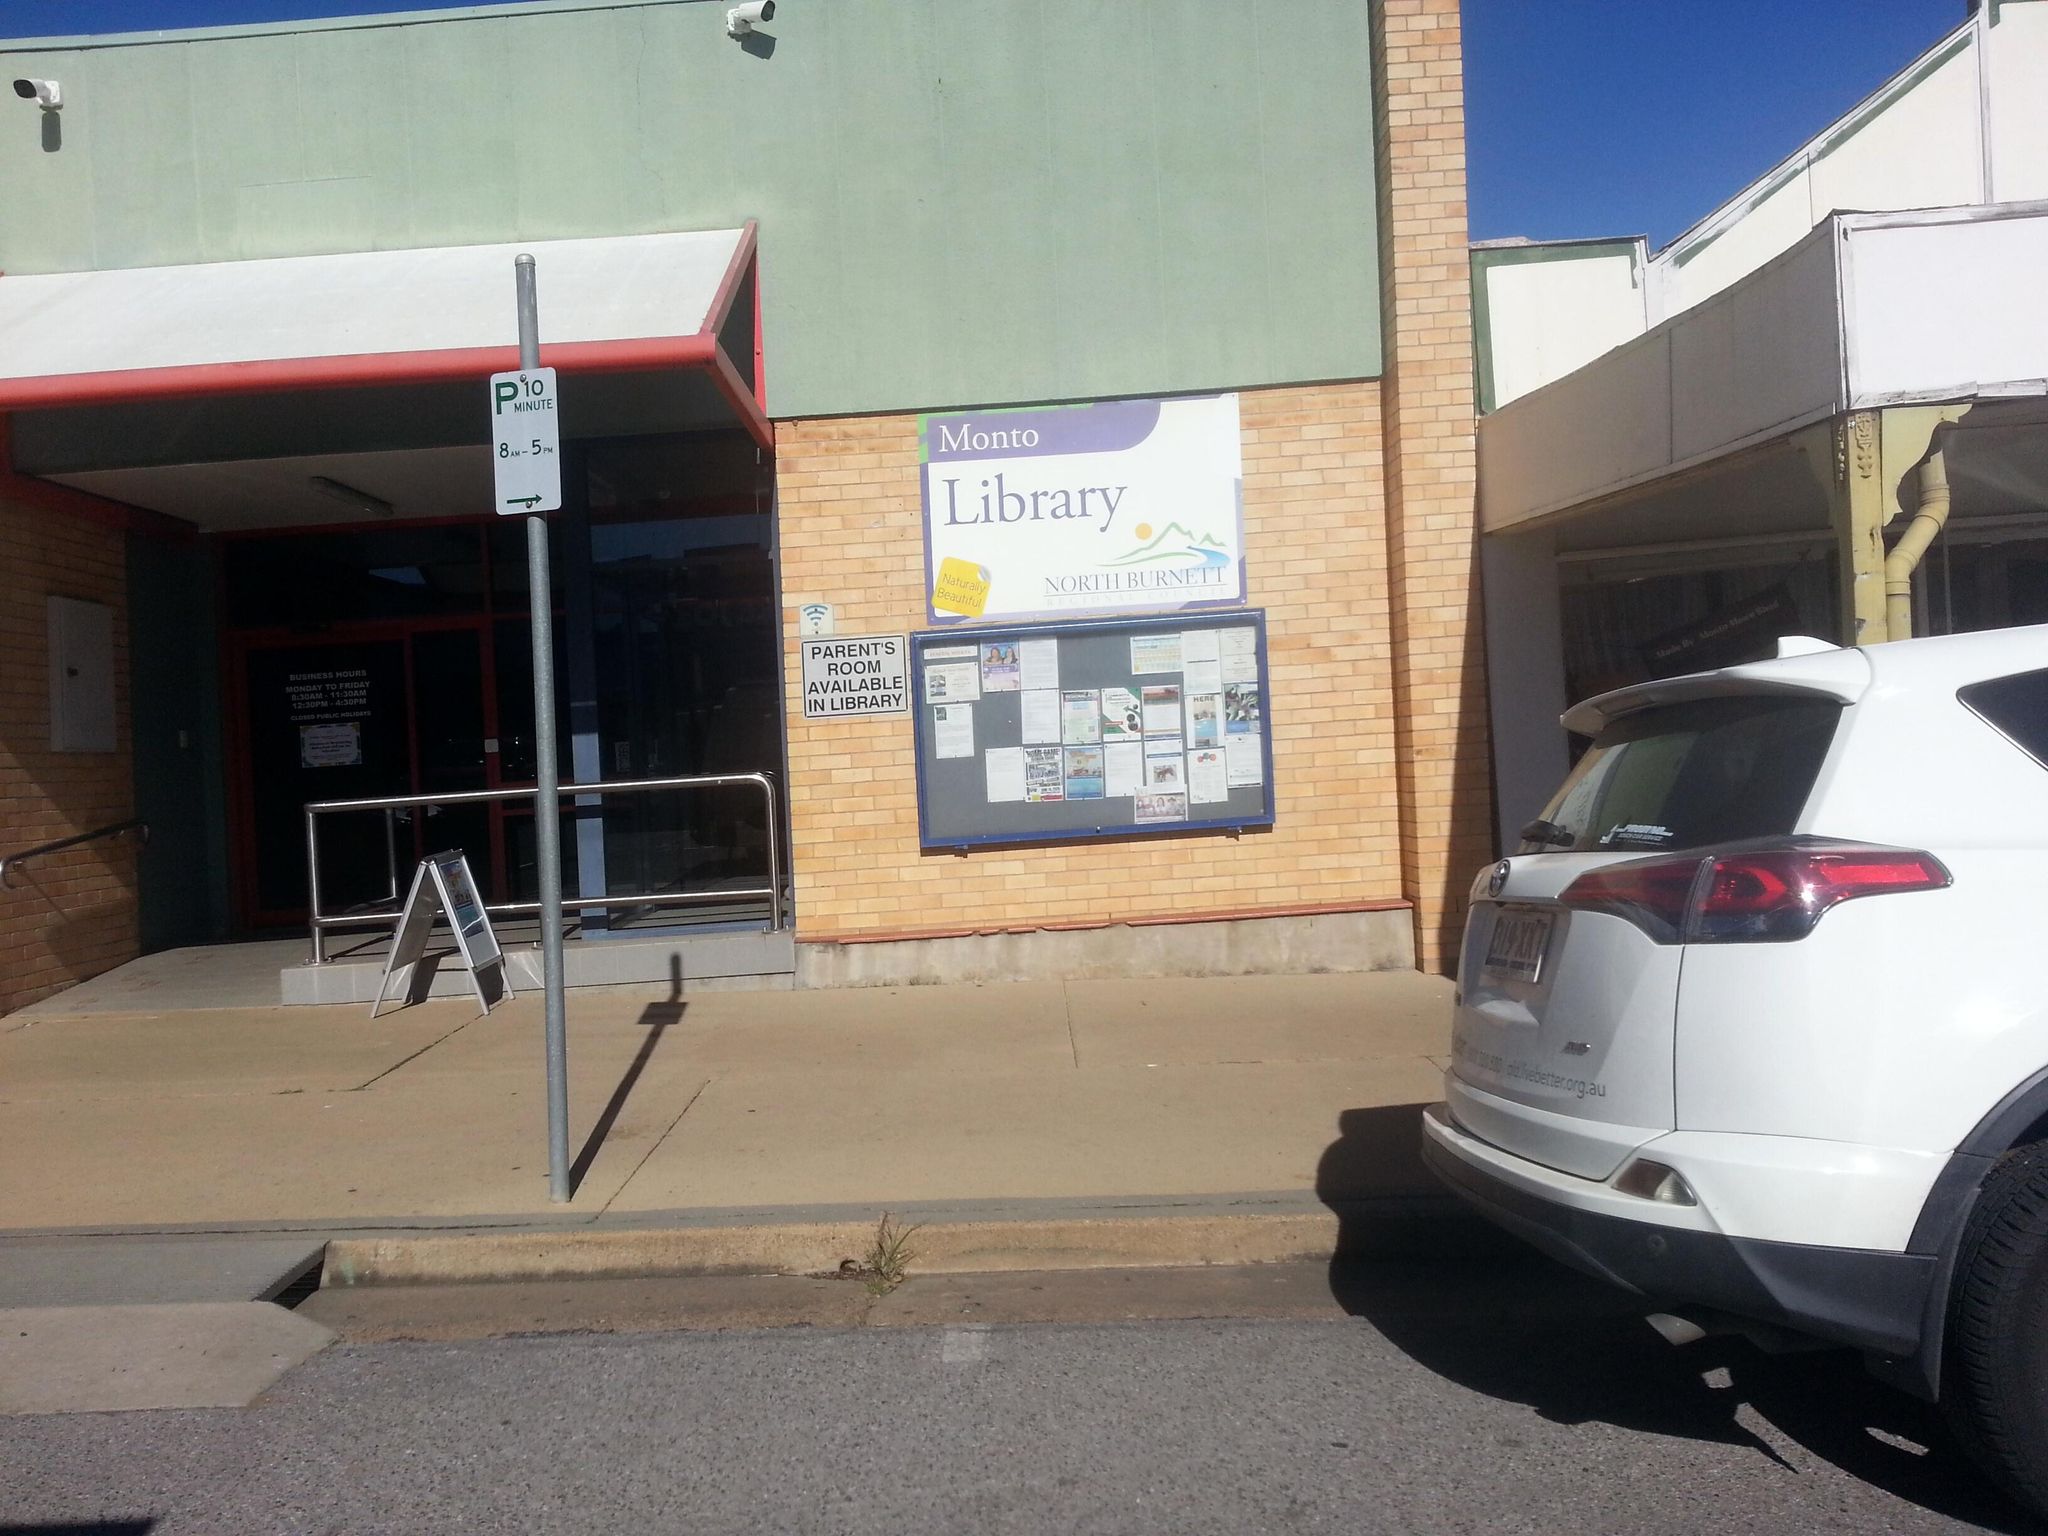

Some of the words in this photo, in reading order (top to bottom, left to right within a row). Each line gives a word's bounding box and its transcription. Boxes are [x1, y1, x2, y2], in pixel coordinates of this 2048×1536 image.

[495, 381, 518, 415] P
[524, 379, 544, 397] 10
[514, 399, 553, 413] MINUTE
[938, 423, 1039, 453] Monto
[942, 473, 1127, 533] Library
[943, 573, 986, 595] Naturally
[1045, 573, 1119, 594] NORTH
[1128, 566, 1227, 588] BURNETT
[936, 587, 983, 608] Beautiful
[811, 641, 896, 660] PARENT'S
[289, 672, 333, 681] BUSINESS
[335, 669, 367, 678] HOURS
[827, 660, 882, 676] ROOM
[285, 684, 322, 693] MONDAY
[339, 681, 370, 690] FRIDAY
[330, 689, 367, 698] 11:30AM
[808, 676, 903, 695] AVAILABLE
[292, 700, 328, 709] 12:30PM
[335, 698, 367, 706] 4:30PM
[808, 698, 825, 712] IN
[831, 693, 903, 711] LIBRARY
[290, 713, 315, 721] CLOSED
[317, 712, 340, 720] PUBLIC
[341, 710, 372, 718] HOLIDAYS
